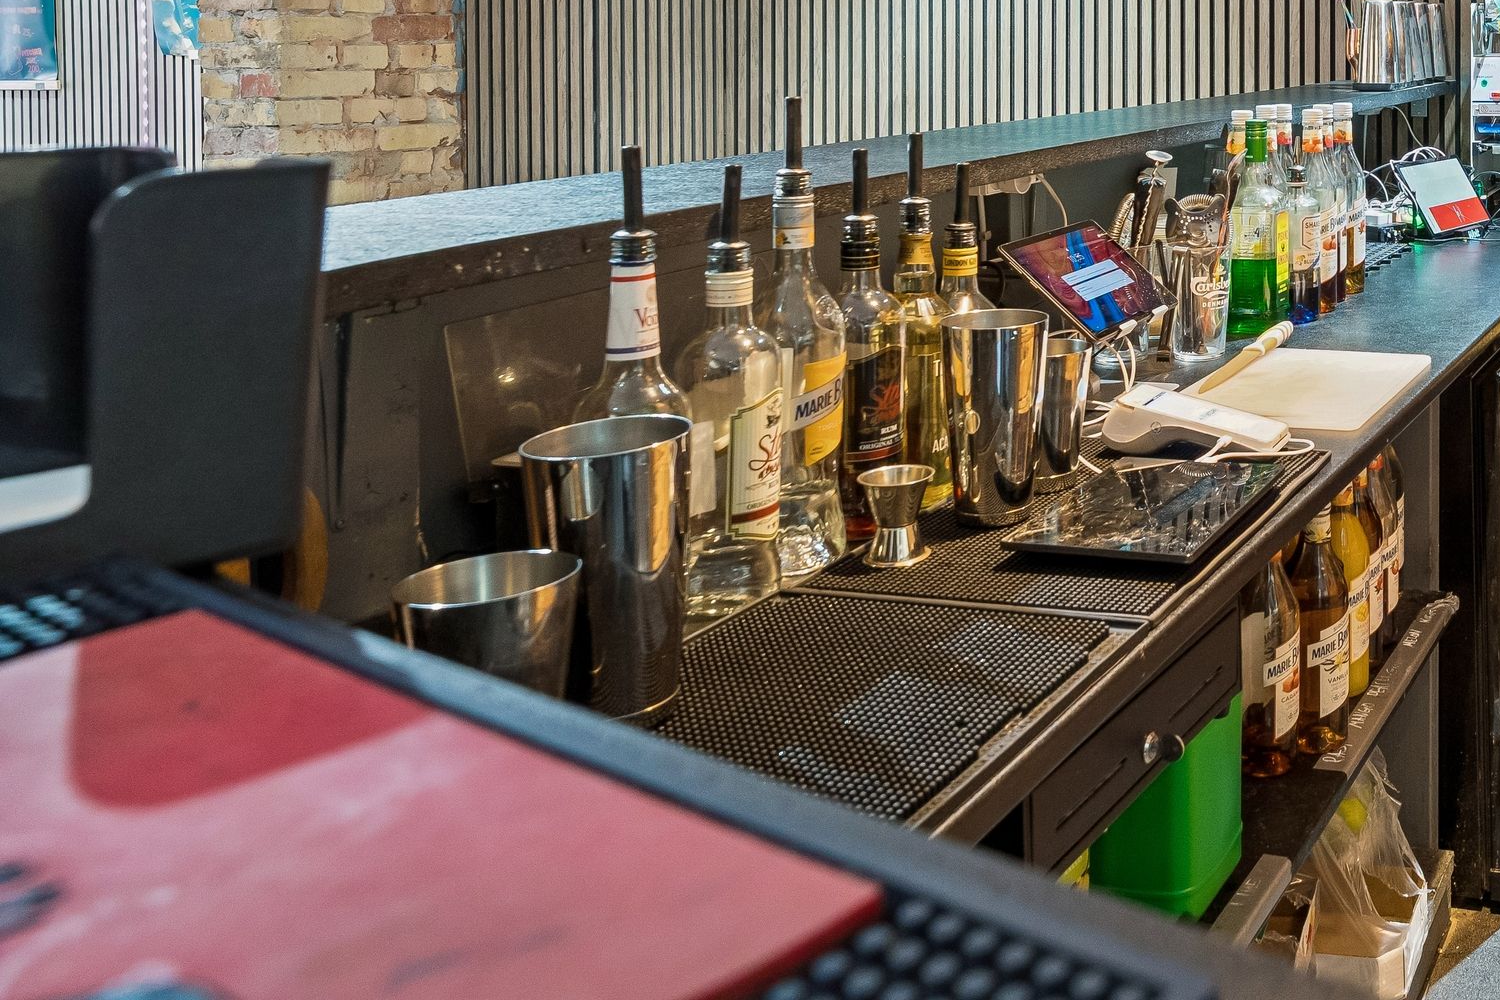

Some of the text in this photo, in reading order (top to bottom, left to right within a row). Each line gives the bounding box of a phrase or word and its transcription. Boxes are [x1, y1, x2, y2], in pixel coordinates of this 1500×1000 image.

[795, 391, 833, 422] MARIE
[859, 437, 893, 451] ORIGINAL
[1311, 639, 1337, 660] MARIE
[1267, 655, 1291, 680] MARIE
